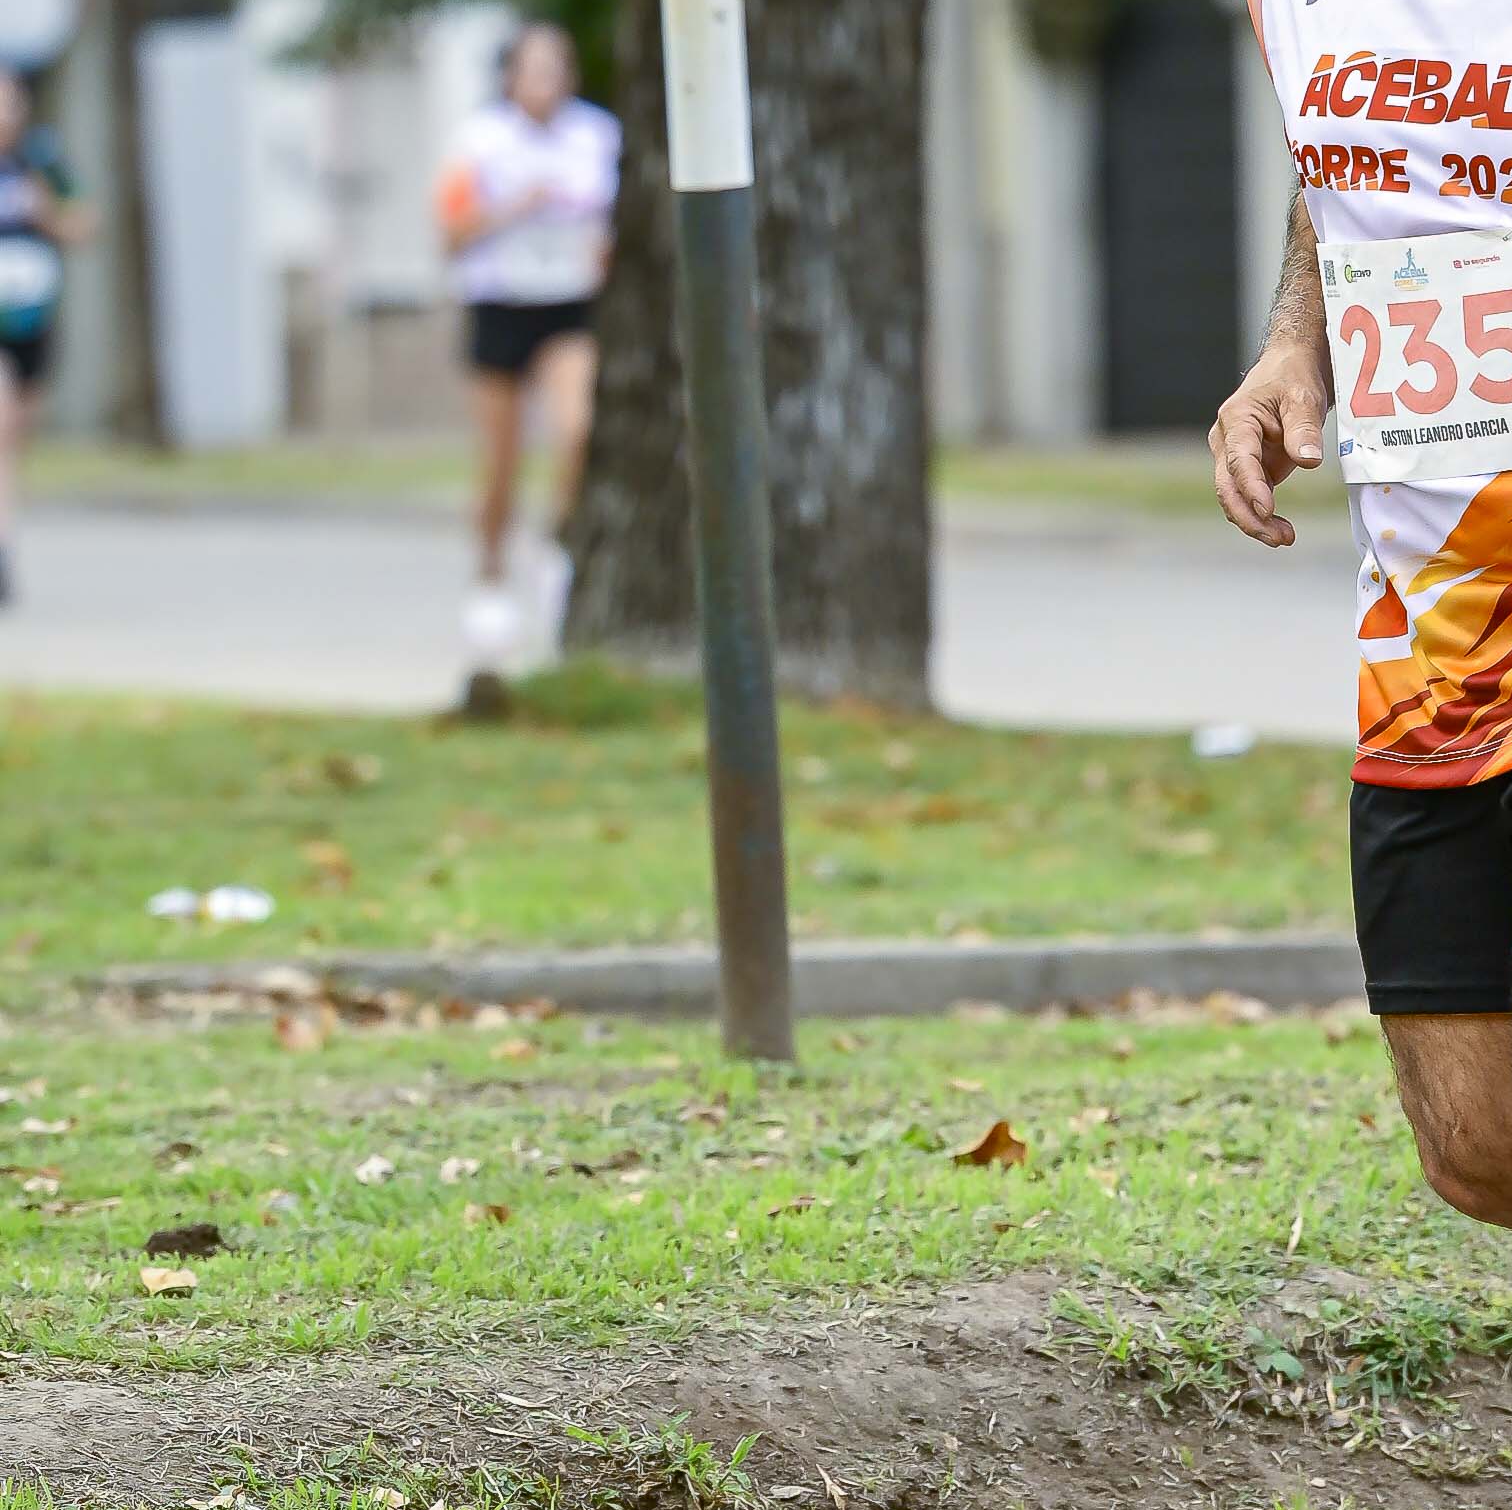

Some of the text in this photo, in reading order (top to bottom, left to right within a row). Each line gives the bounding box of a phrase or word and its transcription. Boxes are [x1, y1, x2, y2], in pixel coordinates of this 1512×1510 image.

[1381, 417, 1510, 447] GASTON LEANDRO GARCIA
